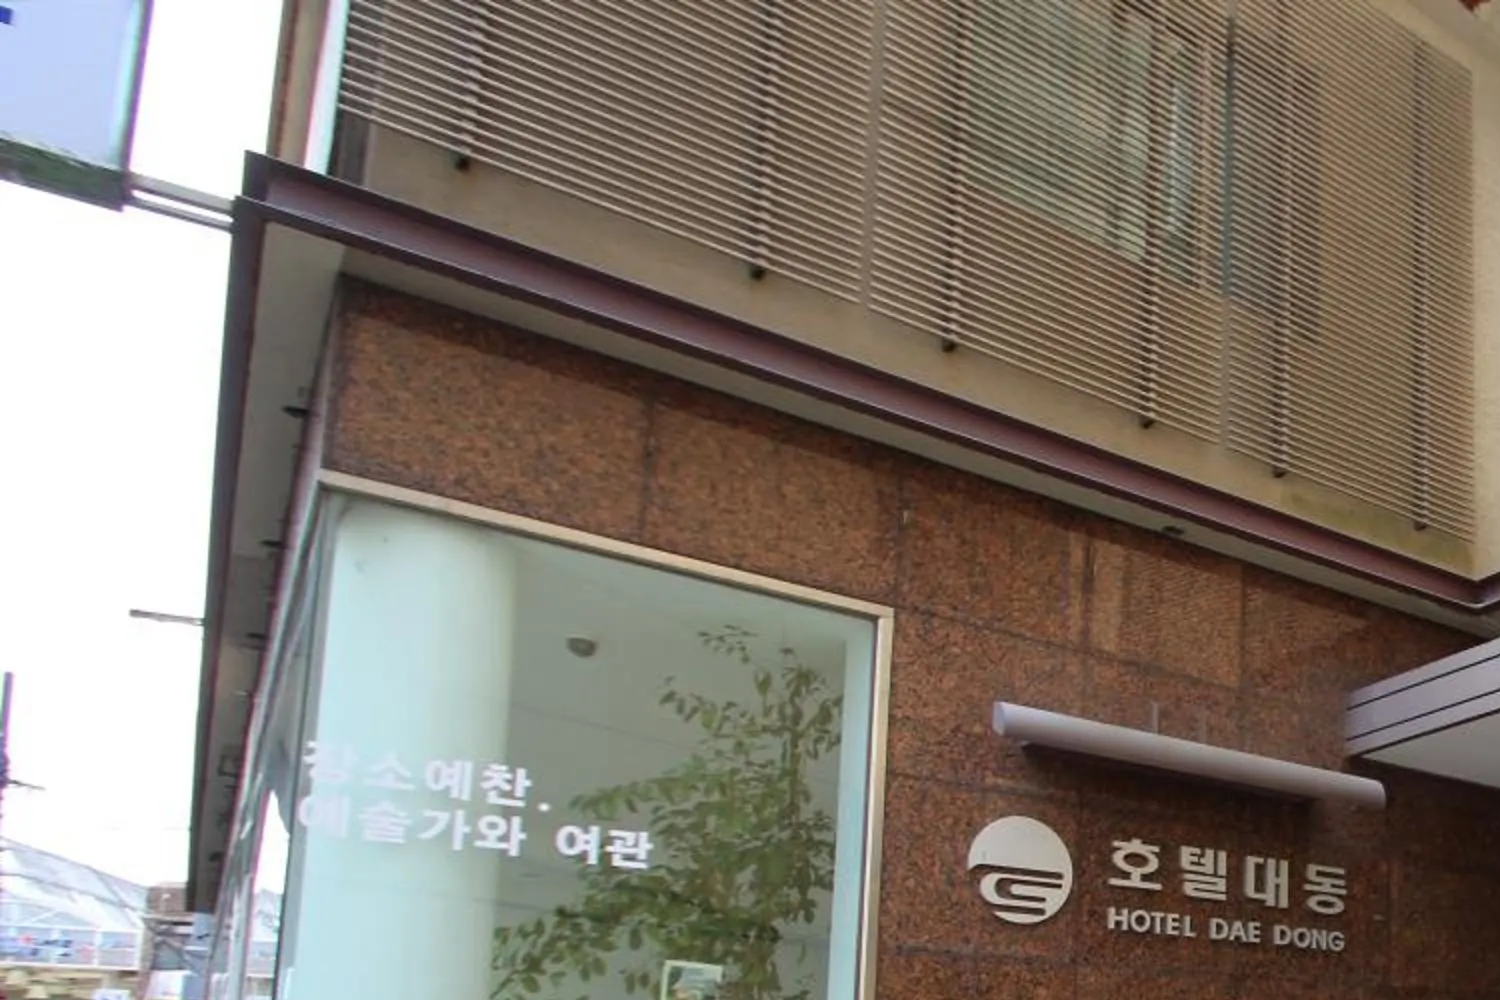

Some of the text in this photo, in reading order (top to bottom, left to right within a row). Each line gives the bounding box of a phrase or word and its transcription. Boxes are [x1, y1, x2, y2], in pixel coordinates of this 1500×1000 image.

[297, 794, 655, 870] 예술가와 여관
[1107, 837, 1348, 916] 호텔대동
[1106, 907, 1346, 952] HOTEL DAE DONG
